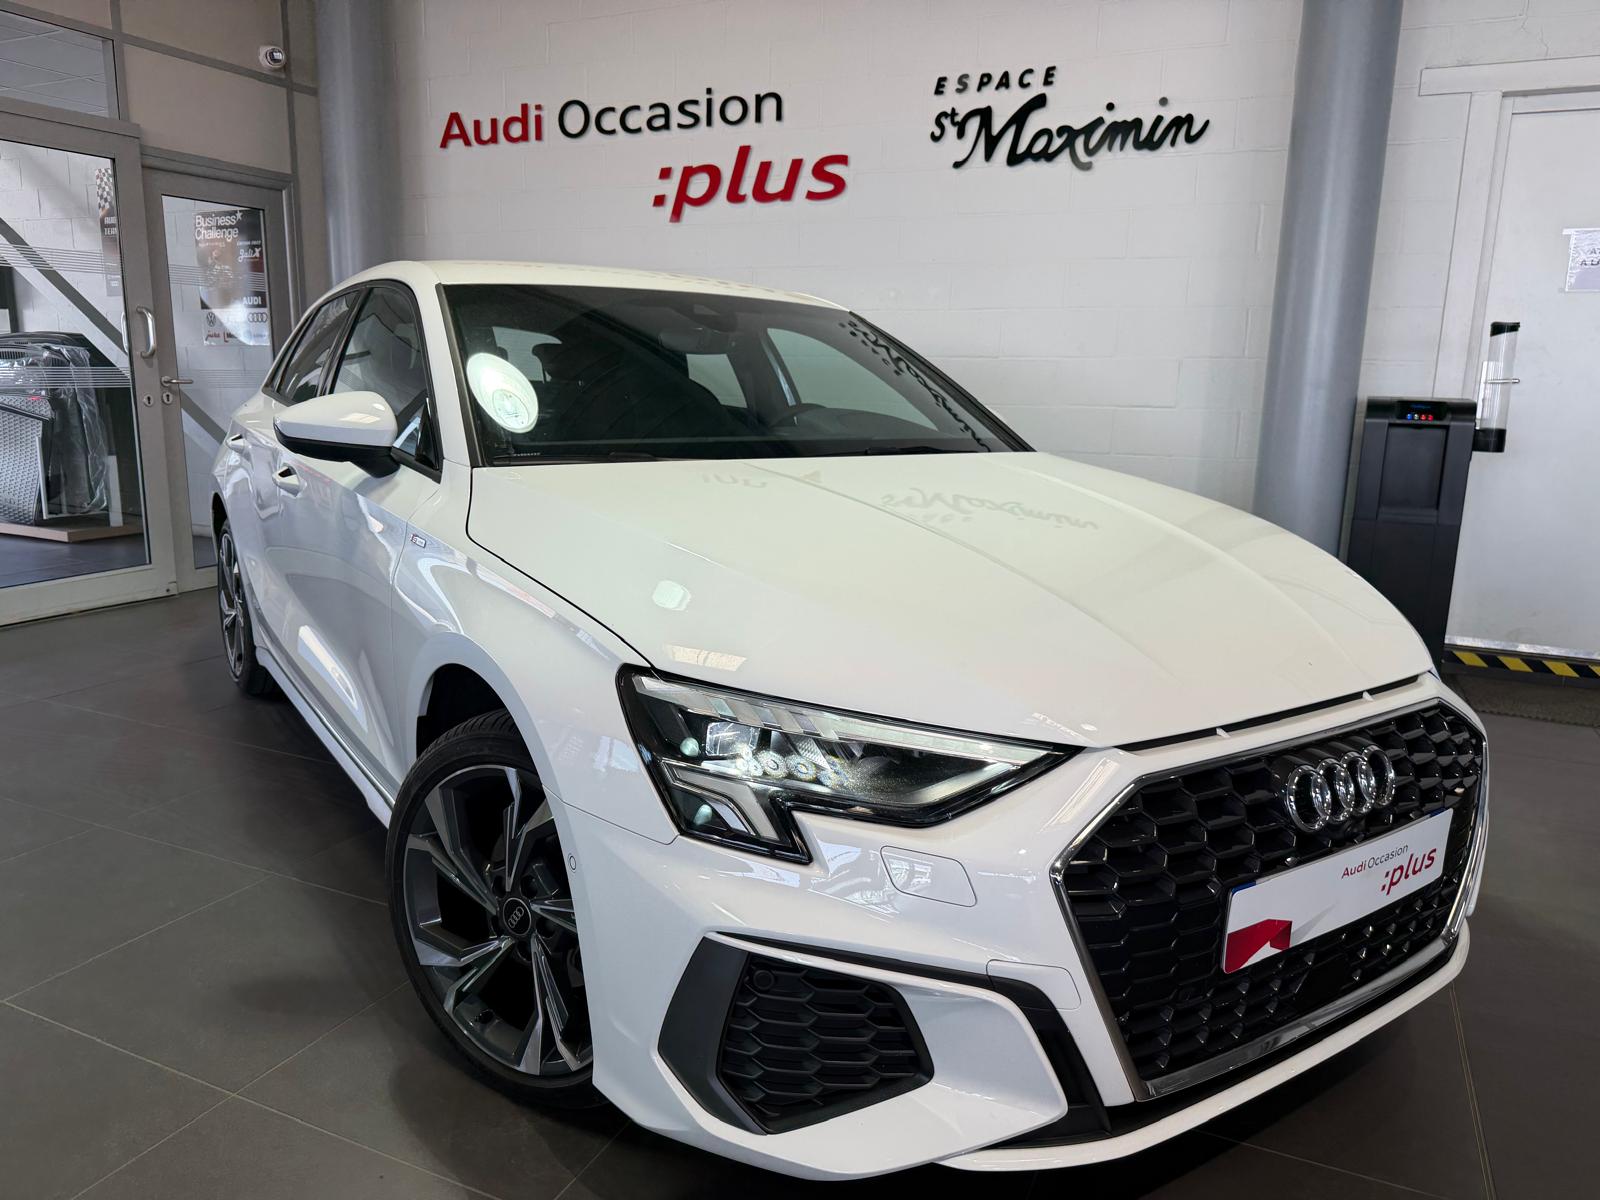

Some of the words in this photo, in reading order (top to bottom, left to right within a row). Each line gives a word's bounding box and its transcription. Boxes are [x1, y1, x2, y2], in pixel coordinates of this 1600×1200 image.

[933, 66, 1057, 96] ESPACE
[440, 103, 544, 149] Audi
[557, 87, 784, 139] Occasion
[930, 107, 960, 142] St
[952, 93, 1210, 171] Maximin
[652, 145, 849, 223] :plus
[195, 214, 236, 228] Business
[195, 227, 239, 241] Challenge
[242, 296, 262, 305] AUDI
[1341, 860, 1367, 879] Audi
[1367, 844, 1409, 869] Occasion
[1381, 848, 1437, 895] :plus
